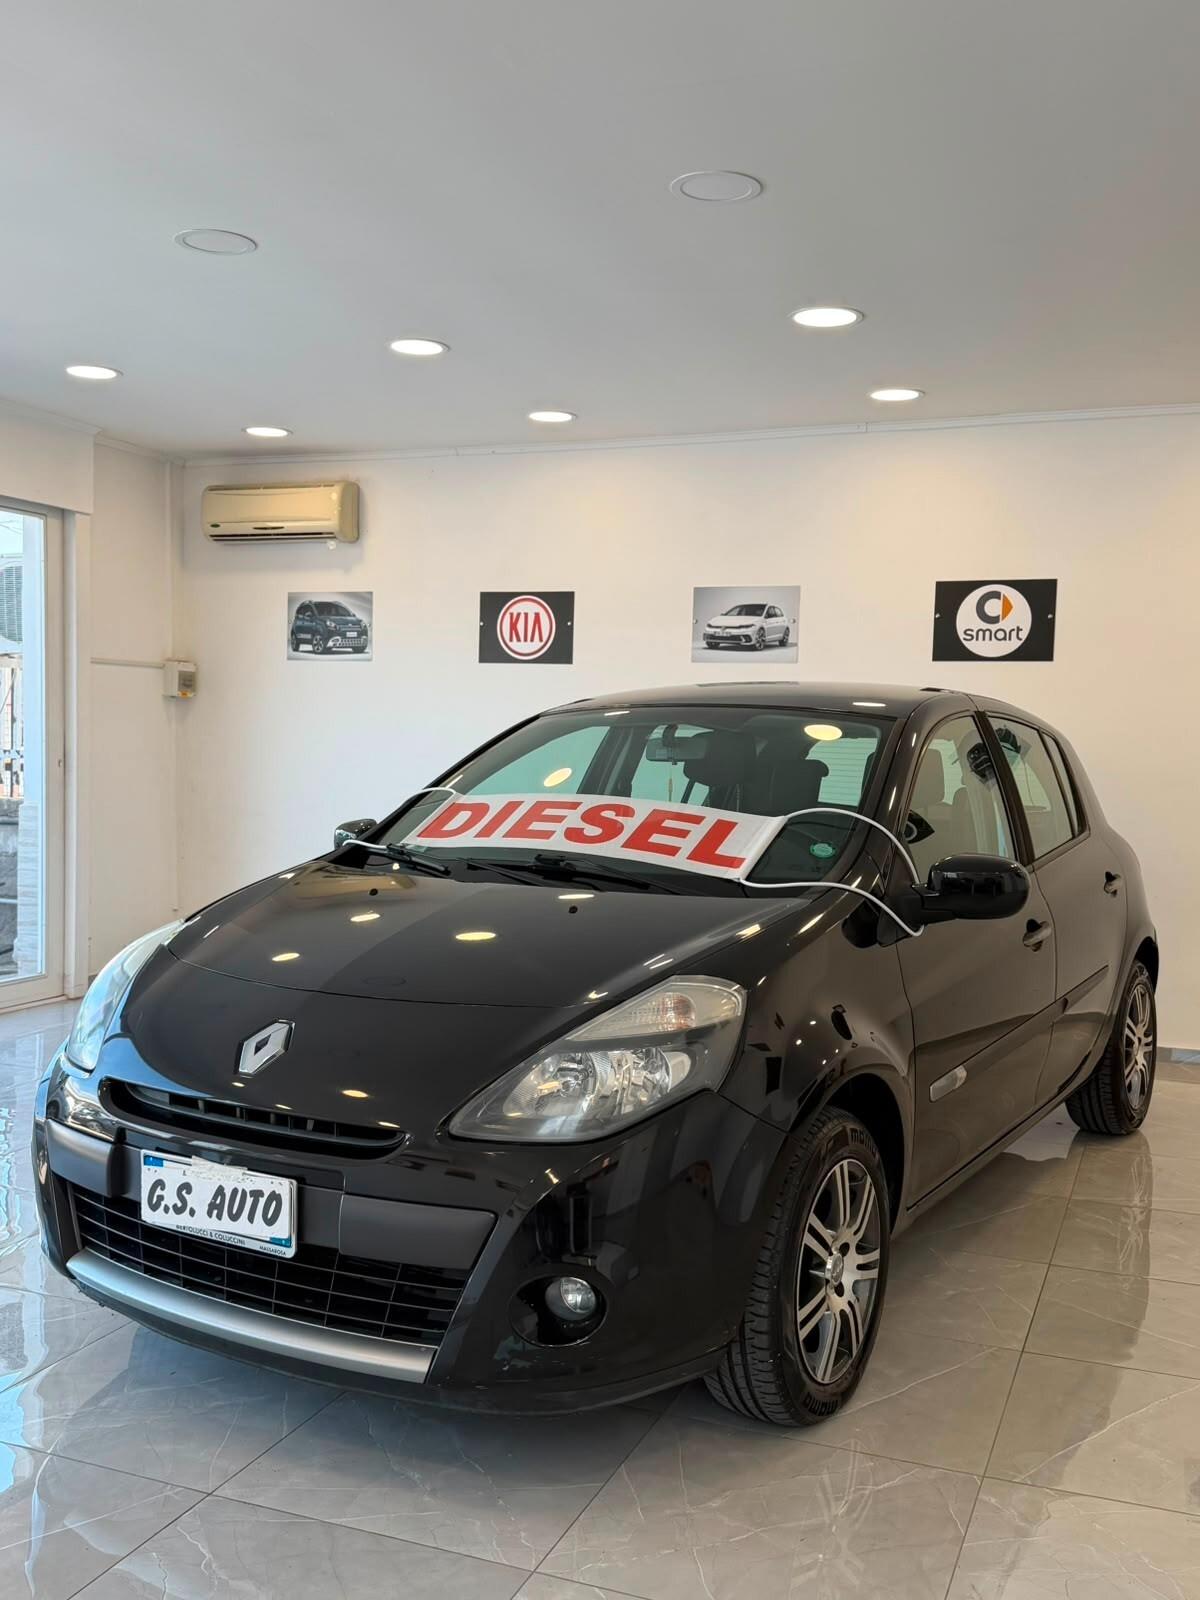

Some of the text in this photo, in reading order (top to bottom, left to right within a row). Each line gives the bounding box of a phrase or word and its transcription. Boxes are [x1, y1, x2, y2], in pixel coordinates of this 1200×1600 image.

[509, 612, 543, 643] KIA
[963, 626, 1023, 642] smart
[417, 799, 747, 869] DIESEL
[147, 1178, 283, 1227] G.S. AUTO
